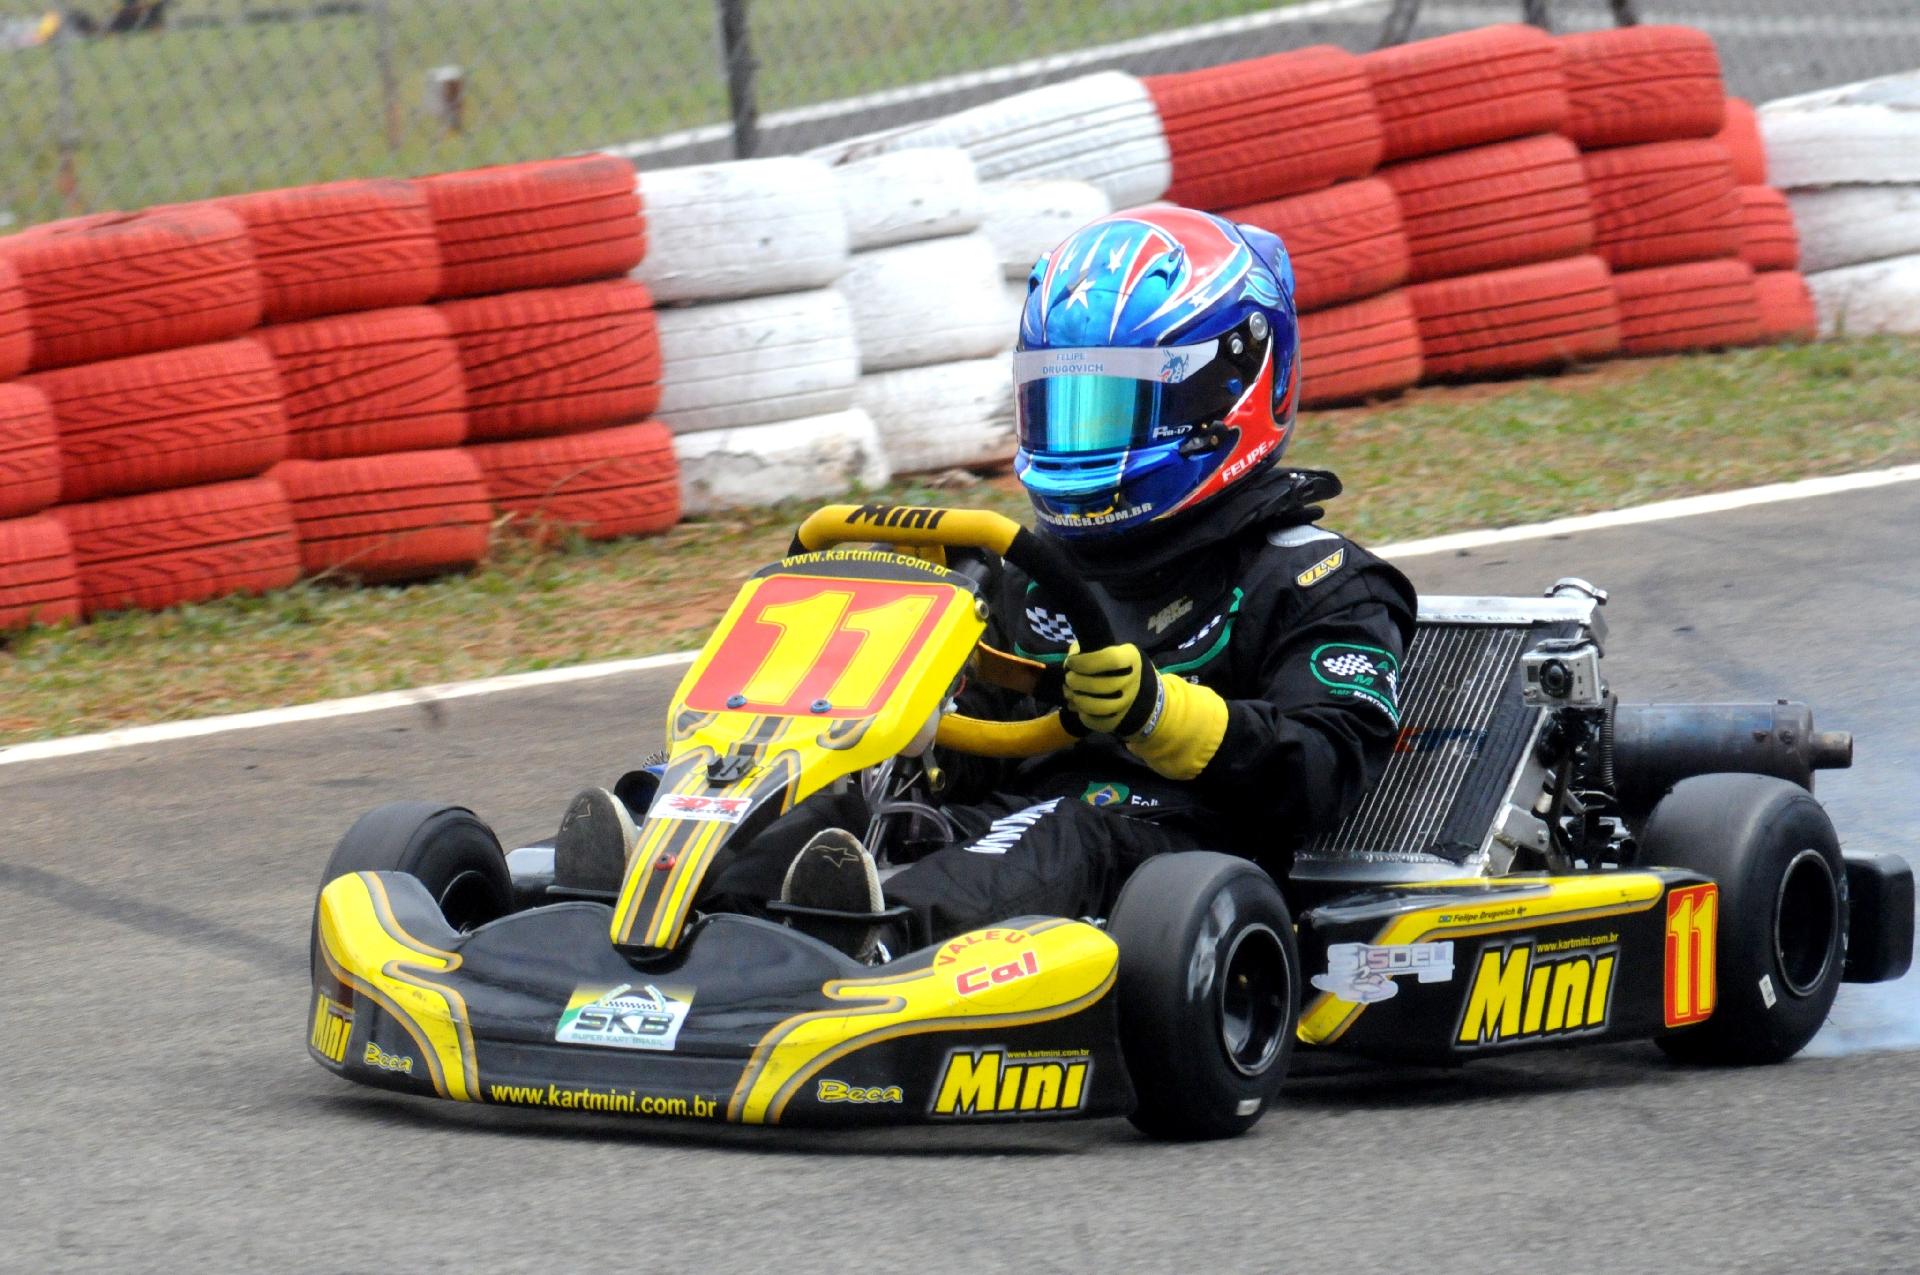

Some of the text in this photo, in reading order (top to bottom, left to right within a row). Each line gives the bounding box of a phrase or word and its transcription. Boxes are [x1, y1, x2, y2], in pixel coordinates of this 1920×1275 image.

[1042, 363, 1104, 375] DRUGOVICH
[1222, 441, 1268, 482] FELIPE
[781, 550, 952, 577] www.kartmini.com.br
[741, 591, 938, 710] 11
[1536, 932, 1620, 953] www.kartmini.com.br
[1669, 893, 1715, 1017] 11
[1455, 942, 1615, 1047] Mini
[574, 1006, 675, 1036] SKB
[1007, 1049, 1090, 1059] www.kartmini.com.br
[935, 1049, 1090, 1113] Mini
[490, 1084, 716, 1118] www.kartmini.com.br
